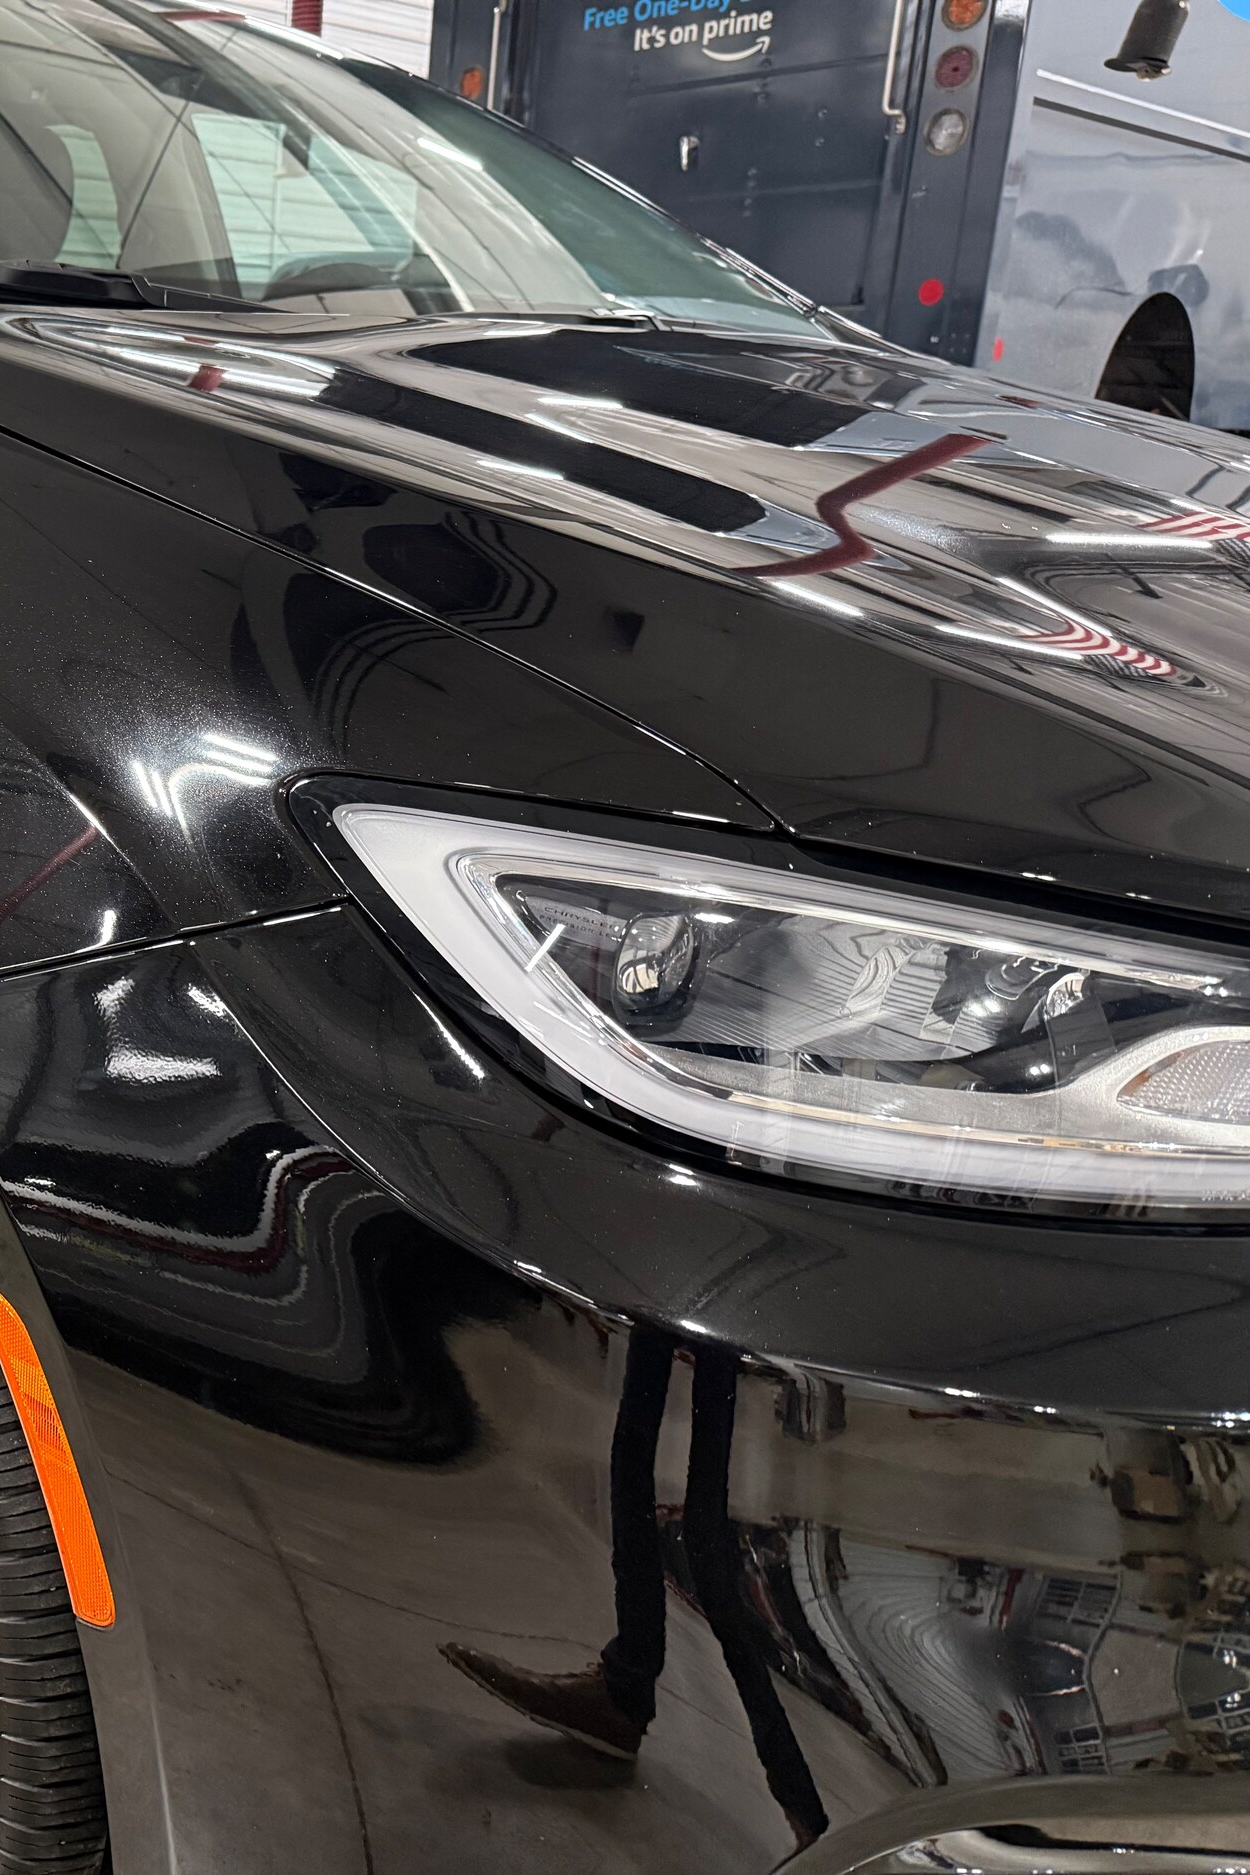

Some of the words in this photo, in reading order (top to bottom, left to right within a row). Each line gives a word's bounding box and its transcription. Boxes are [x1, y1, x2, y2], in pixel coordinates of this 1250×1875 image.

[584, 7, 629, 31] Free
[634, 25, 666, 52] It's
[669, 23, 698, 46] on
[702, 10, 773, 46] prime
